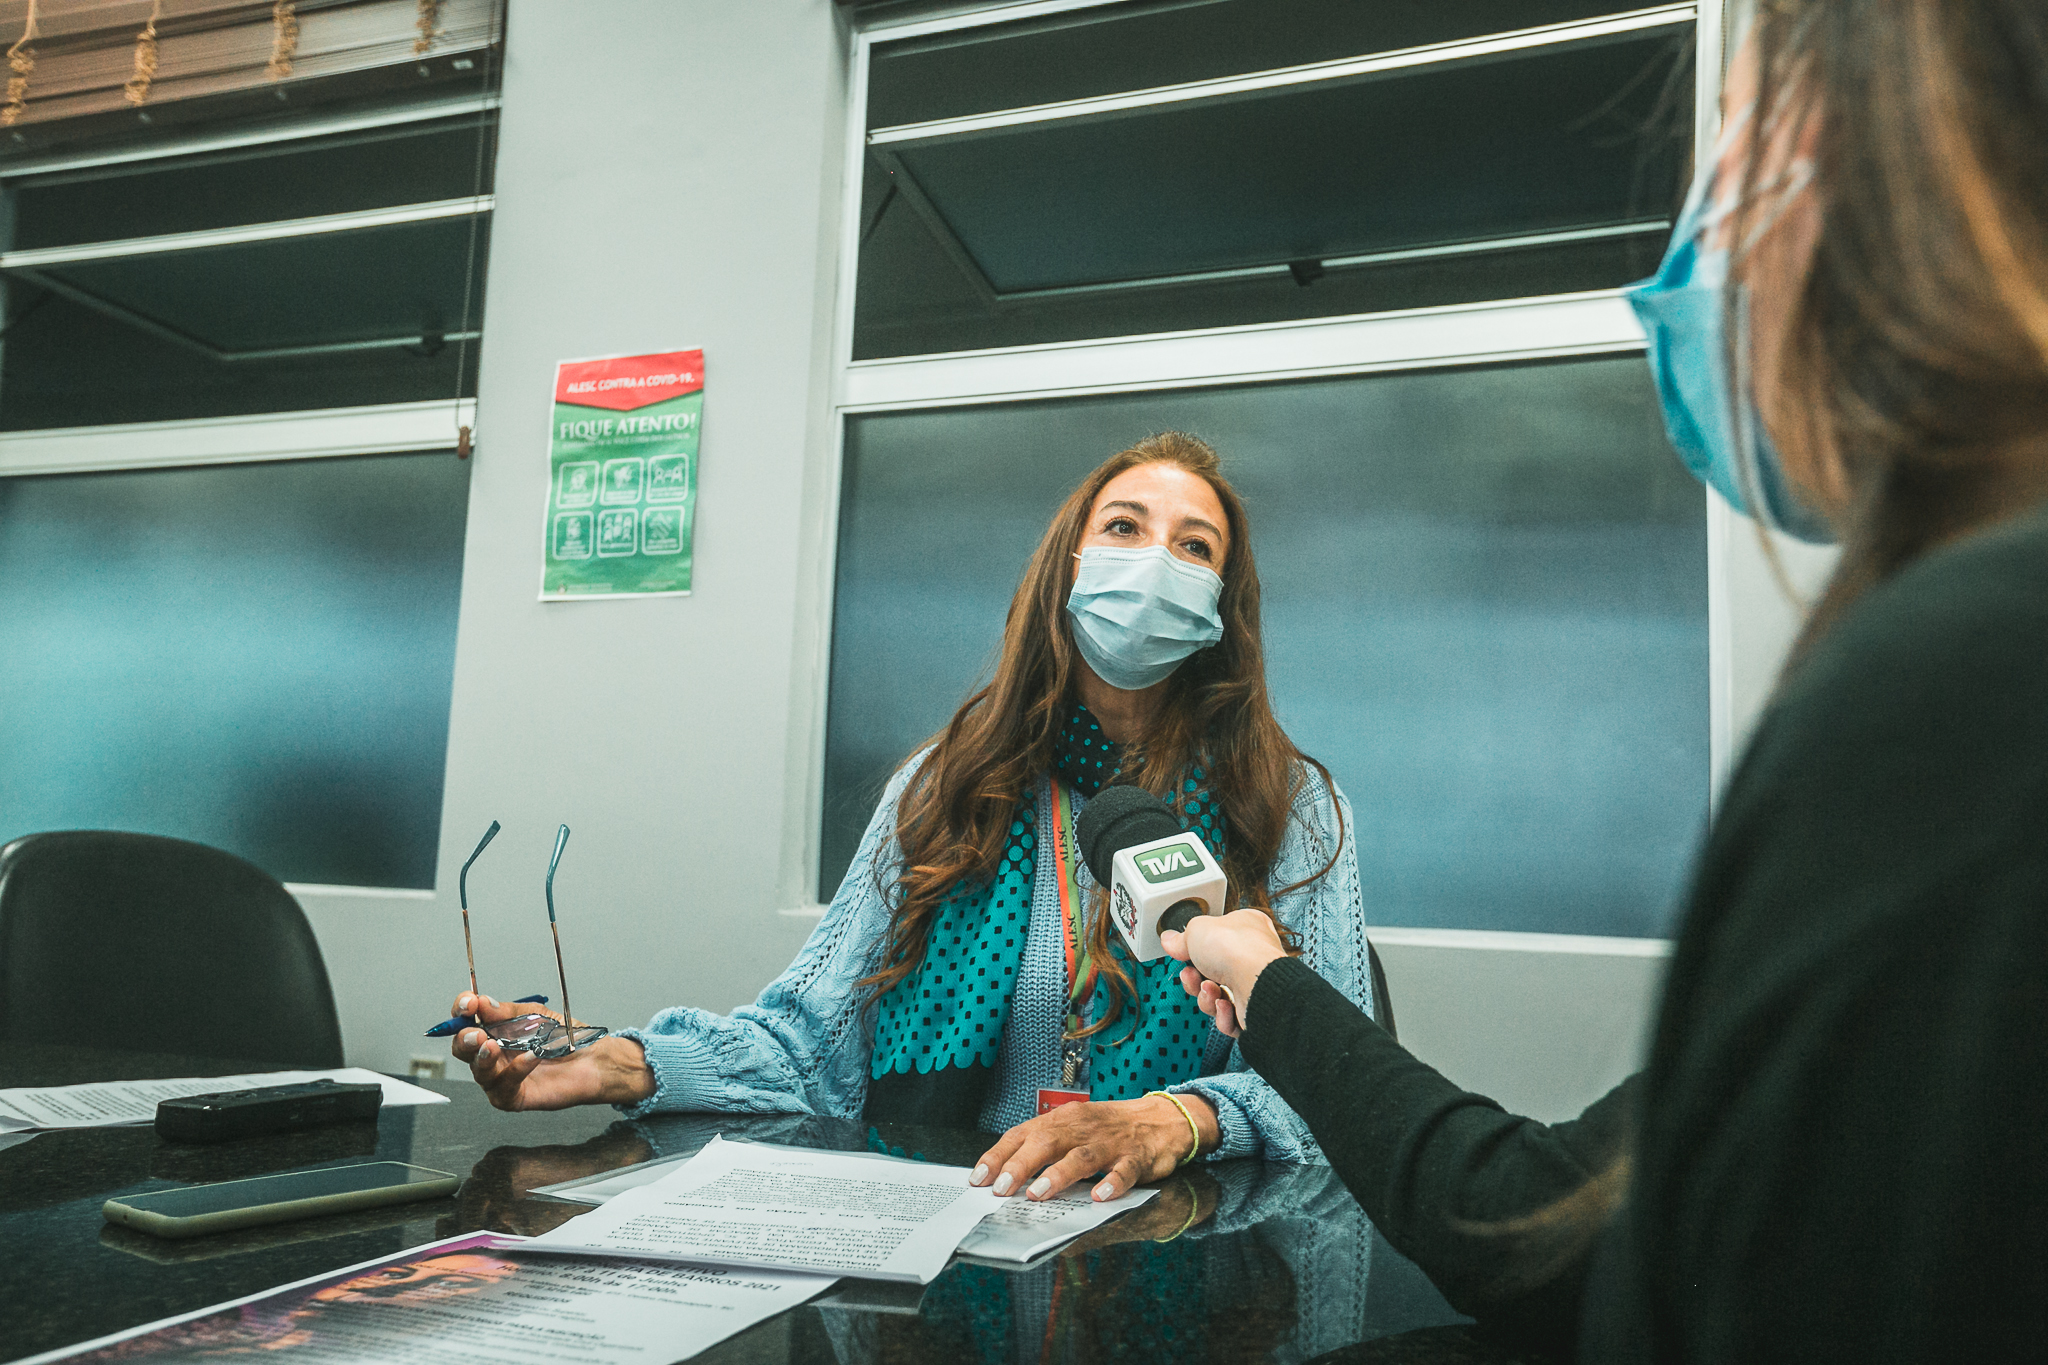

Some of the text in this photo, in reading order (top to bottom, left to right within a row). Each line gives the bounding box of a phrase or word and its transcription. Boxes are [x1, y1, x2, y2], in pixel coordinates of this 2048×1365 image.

[567, 380, 597, 393] ALESC
[597, 377, 635, 391] CONTRA
[635, 377, 646, 388] A
[559, 419, 613, 441] FIQUE
[616, 412, 697, 435] ATENTO!
[1057, 826, 1069, 863] ALESC
[1066, 912, 1078, 950] ALESC
[558, 1273, 602, 1283] 8:00h
[617, 1271, 637, 1279] de
[639, 1276, 688, 1287] Junho
[646, 1267, 673, 1276] DE
[672, 1272, 742, 1286] BARROS
[743, 1282, 782, 1291] 2021
